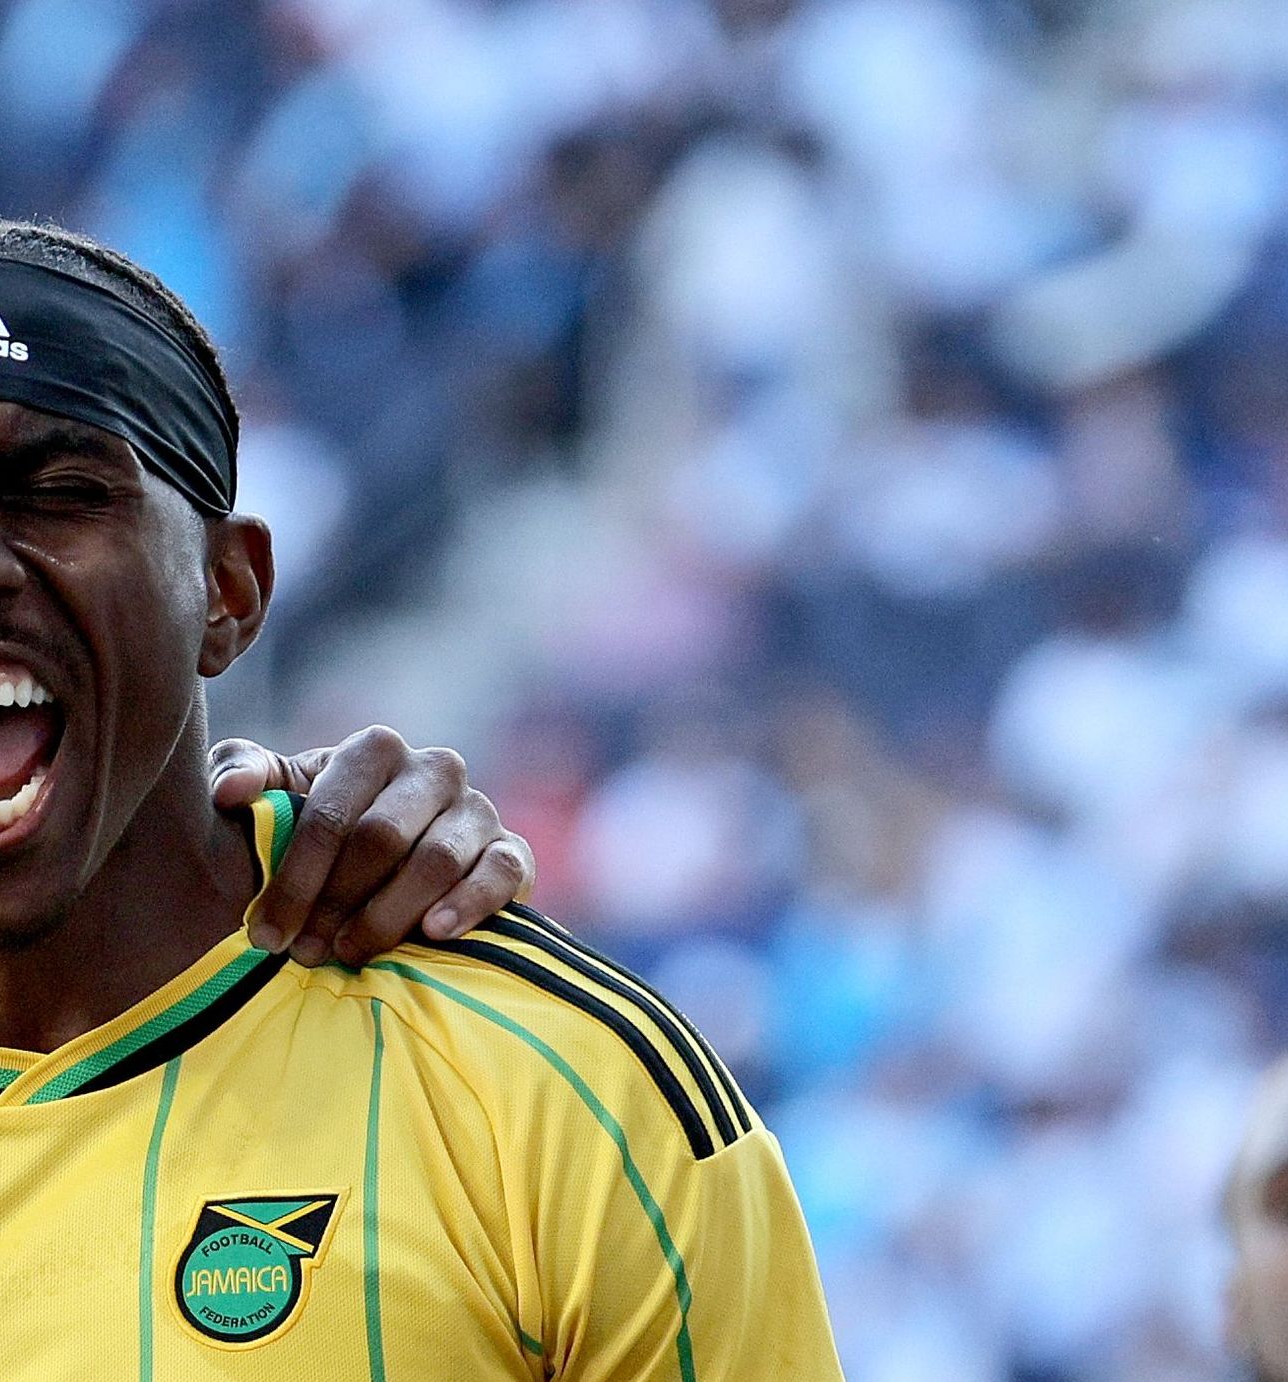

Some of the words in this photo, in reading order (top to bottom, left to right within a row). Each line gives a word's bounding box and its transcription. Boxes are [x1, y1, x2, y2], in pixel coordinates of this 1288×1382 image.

[202, 1233, 273, 1257] FOOTBALL
[186, 1265, 288, 1297] JAMAICA
[199, 1302, 275, 1328] FEDERATION
